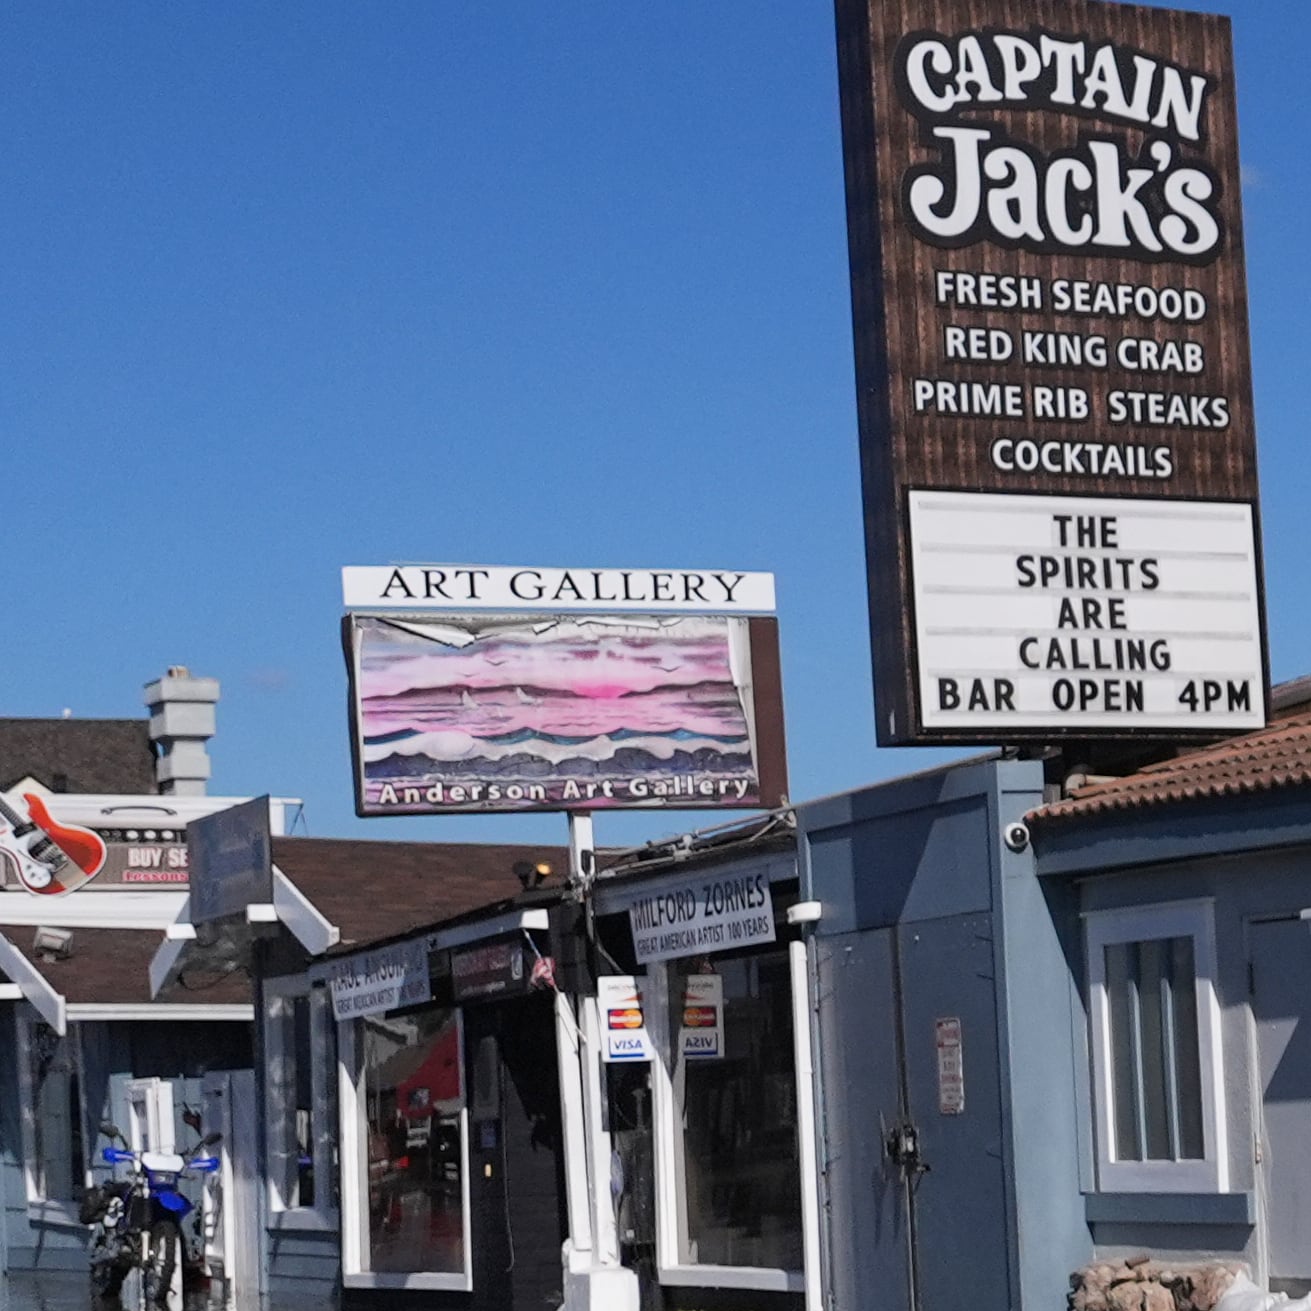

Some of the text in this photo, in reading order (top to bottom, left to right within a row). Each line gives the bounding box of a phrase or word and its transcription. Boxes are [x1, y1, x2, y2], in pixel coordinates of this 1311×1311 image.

[906, 34, 1207, 140] CAPTAIN
[910, 126, 1219, 254] Jack's
[936, 271, 1206, 320] FRESH SEAFOOD
[945, 326, 1204, 373] RED KING CRAB
[914, 379, 1230, 428] PRIME RIB STEAKS
[991, 438, 1173, 478] COCKTAILS
[1053, 514, 1118, 548] THE
[378, 568, 747, 603] ART GALLERY
[1016, 554, 1160, 590] SPIRITS
[1058, 597, 1127, 630] ARE
[1018, 637, 1171, 671] CALLING
[938, 677, 1251, 712] BAR OPEN 4PM
[378, 777, 749, 805] Anderson Art Gallery
[127, 848, 189, 867] BUY SE
[632, 873, 765, 932] MILFORD ZORNES
[636, 916, 769, 956] GREAT AMERICAN ARTIST 100 YEARS
[614, 1039, 642, 1050] VISA
